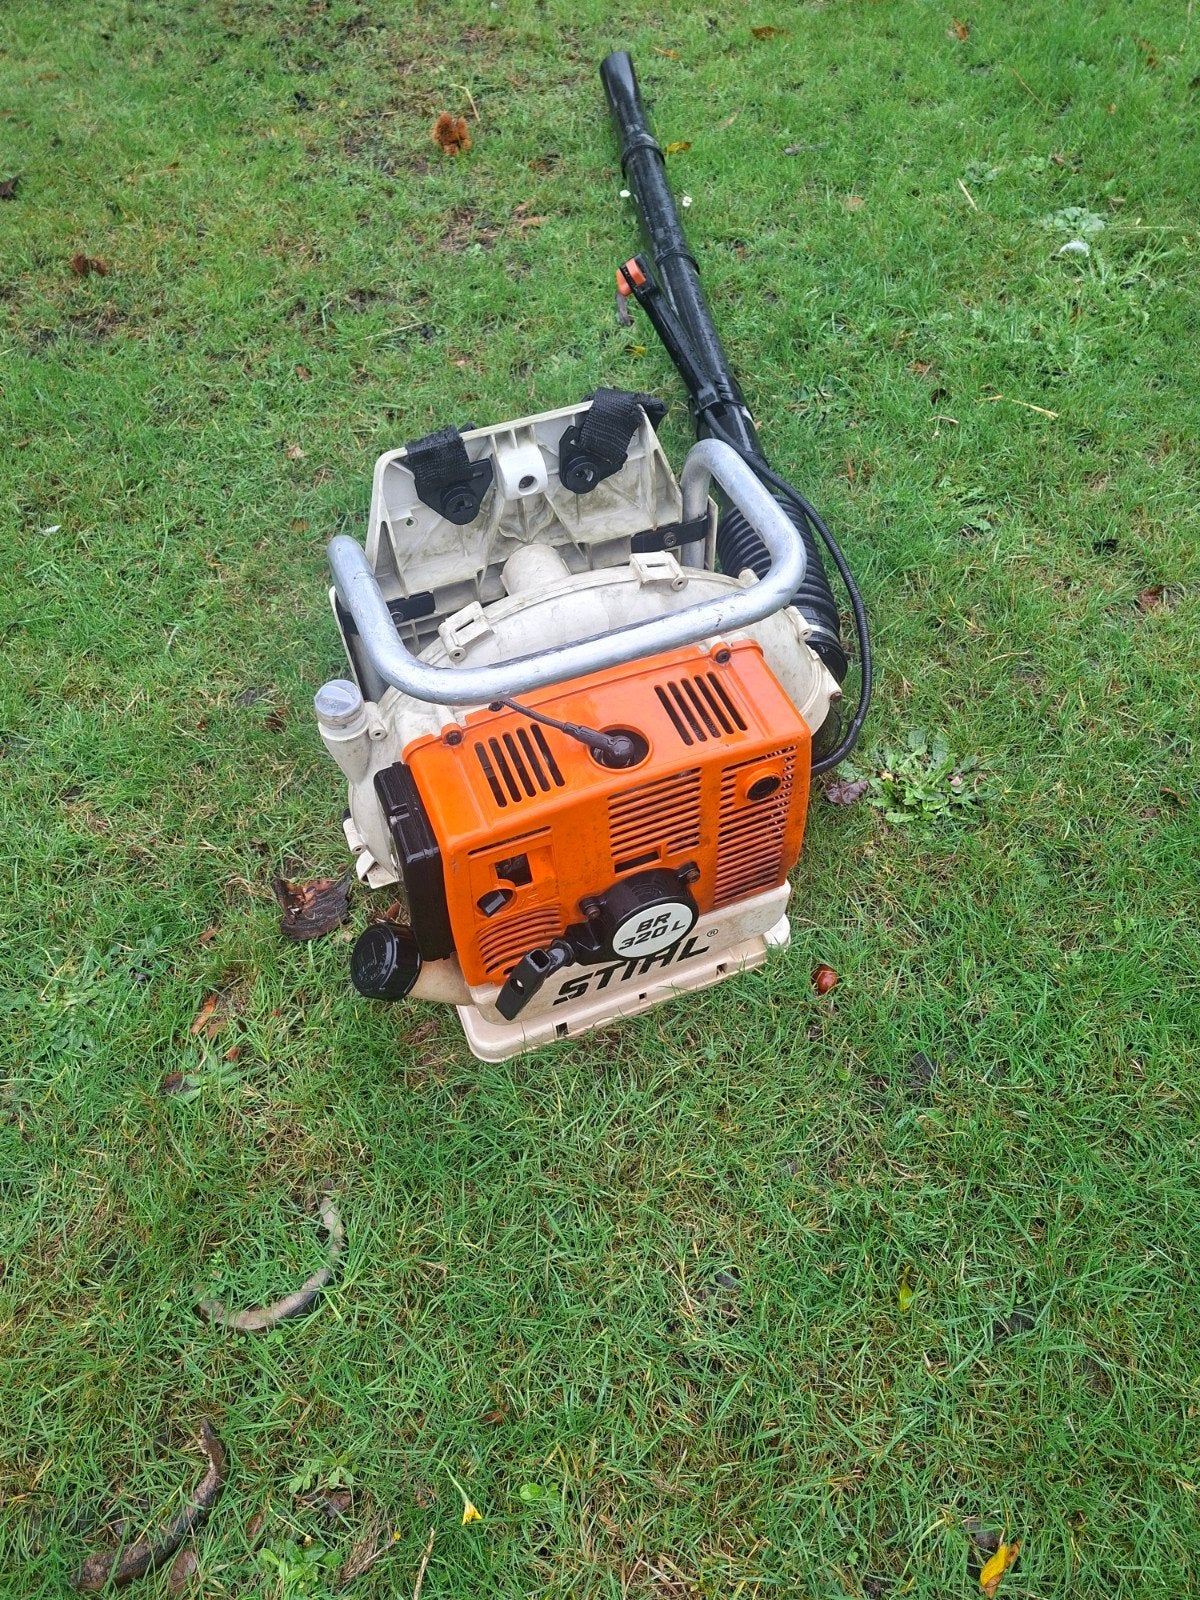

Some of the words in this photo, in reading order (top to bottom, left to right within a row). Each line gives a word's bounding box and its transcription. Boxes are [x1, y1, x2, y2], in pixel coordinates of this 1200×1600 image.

[618, 925, 668, 950] 320
[671, 920, 685, 931] L
[636, 912, 671, 933] BR
